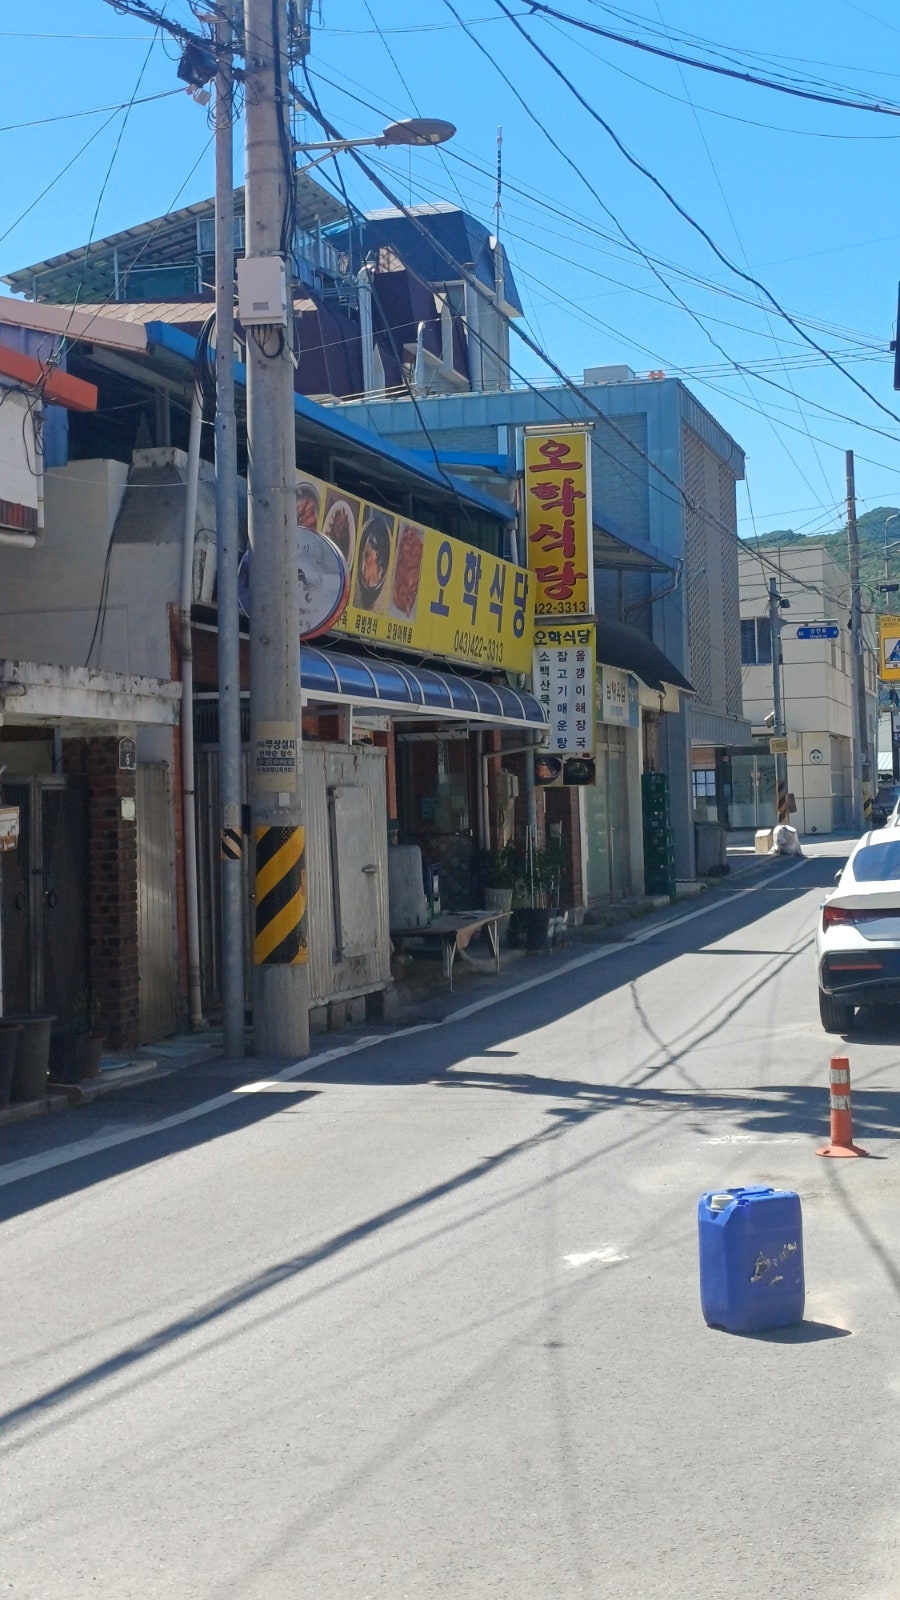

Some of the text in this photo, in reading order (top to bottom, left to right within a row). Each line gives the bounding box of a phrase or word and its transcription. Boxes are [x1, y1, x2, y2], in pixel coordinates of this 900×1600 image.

[528, 438, 588, 601] 오학식당
[430, 540, 529, 638] 오학식당
[534, 628, 591, 646] 오학식당
[453, 629, 504, 662] 043)422-3313
[556, 650, 568, 749] 잡고기매운탕
